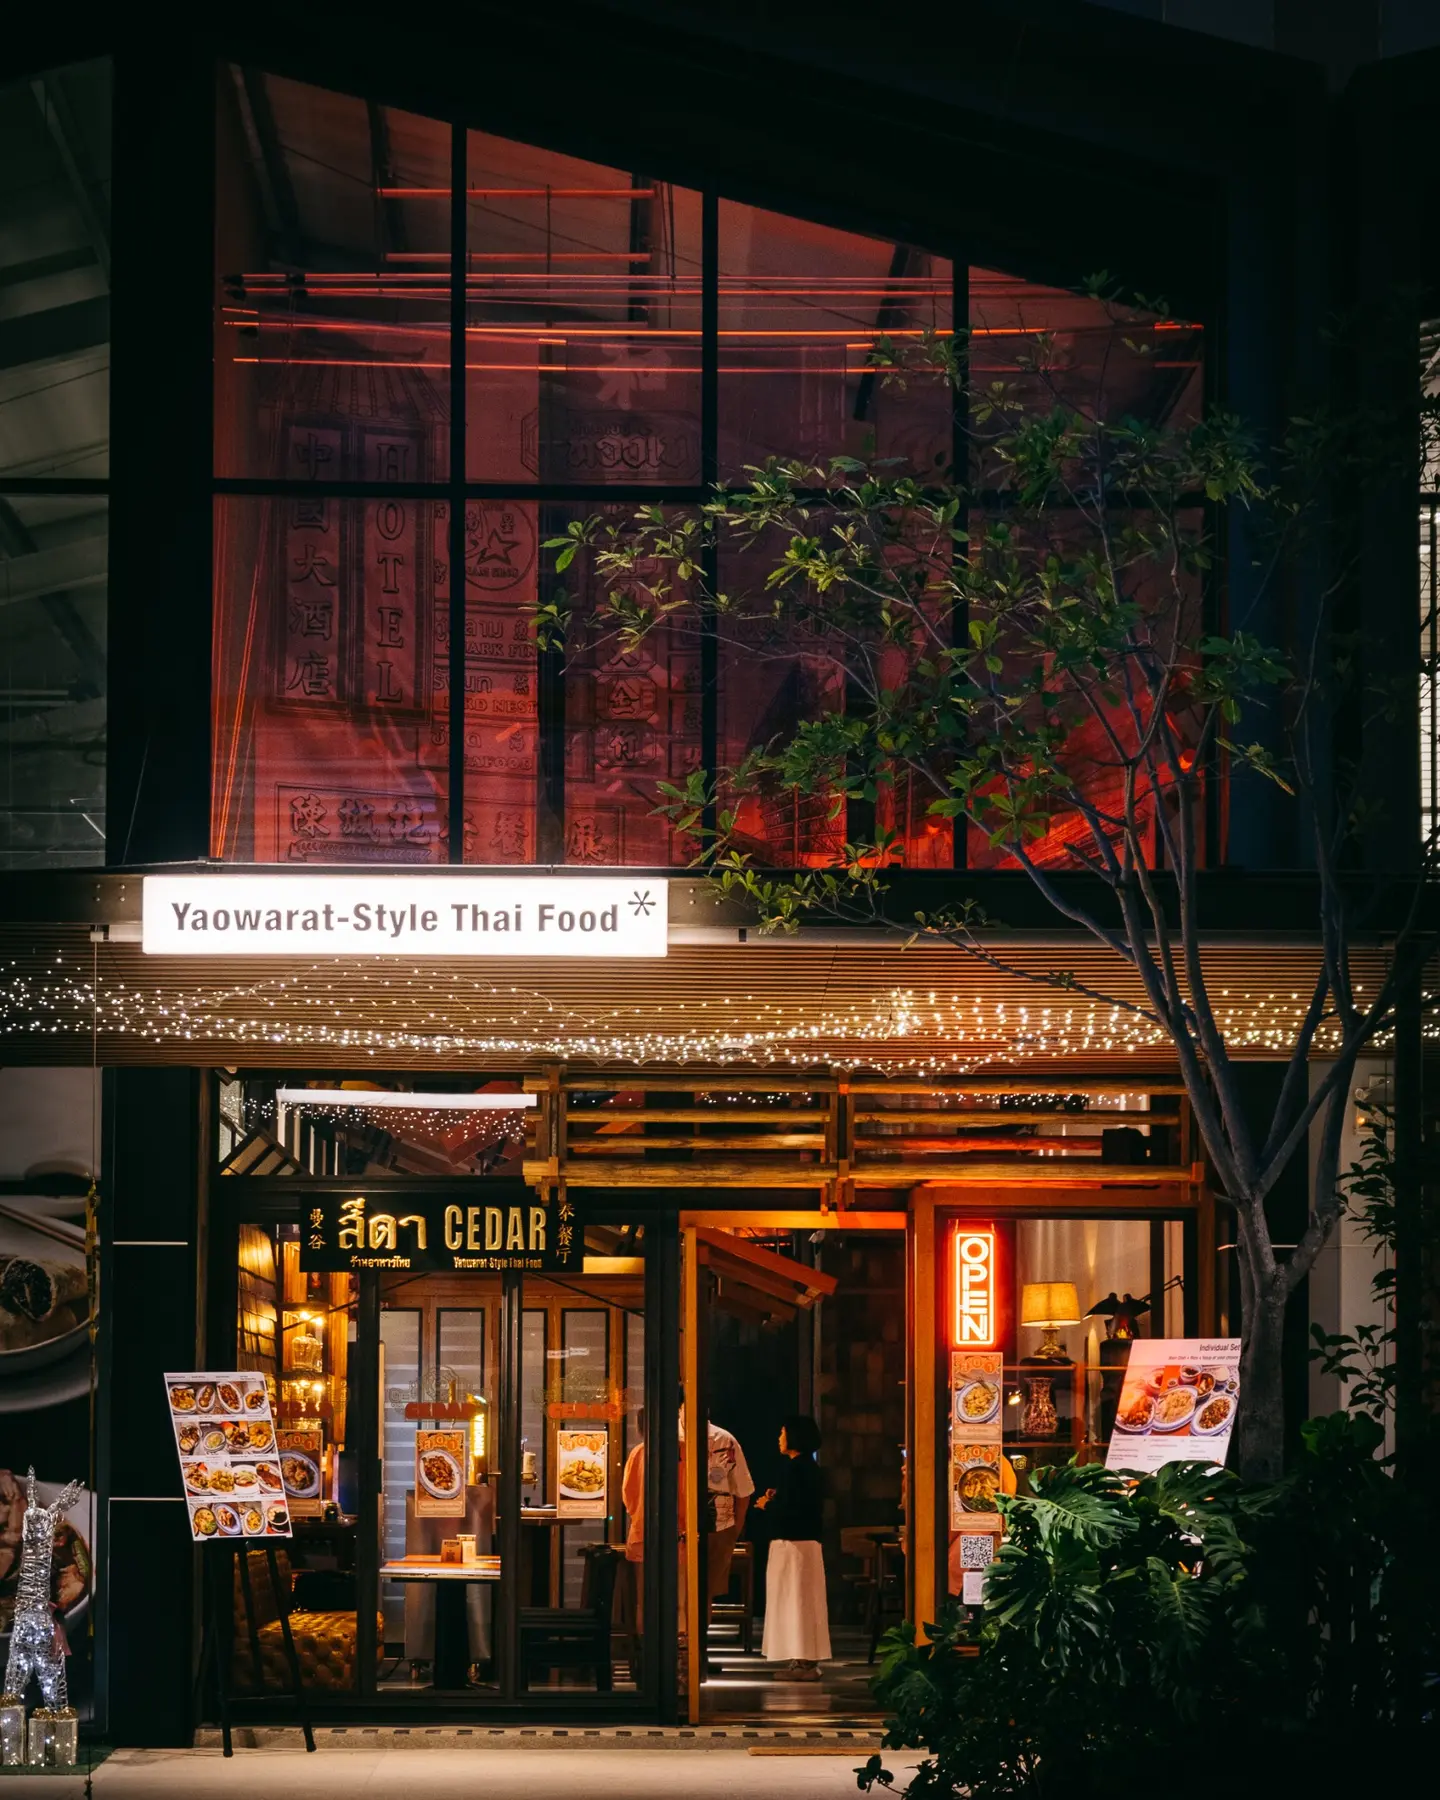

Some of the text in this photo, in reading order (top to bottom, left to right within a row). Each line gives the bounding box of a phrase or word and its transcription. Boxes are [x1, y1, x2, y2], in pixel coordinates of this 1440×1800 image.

[376, 443, 410, 702] HOTEL
[170, 902, 439, 938] Yaowarat-Style
[450, 902, 523, 932] Thai
[444, 1204, 547, 1251] CEDAR
[960, 1236, 990, 1342] OPEN
[1199, 1343, 1229, 1351] Individual
